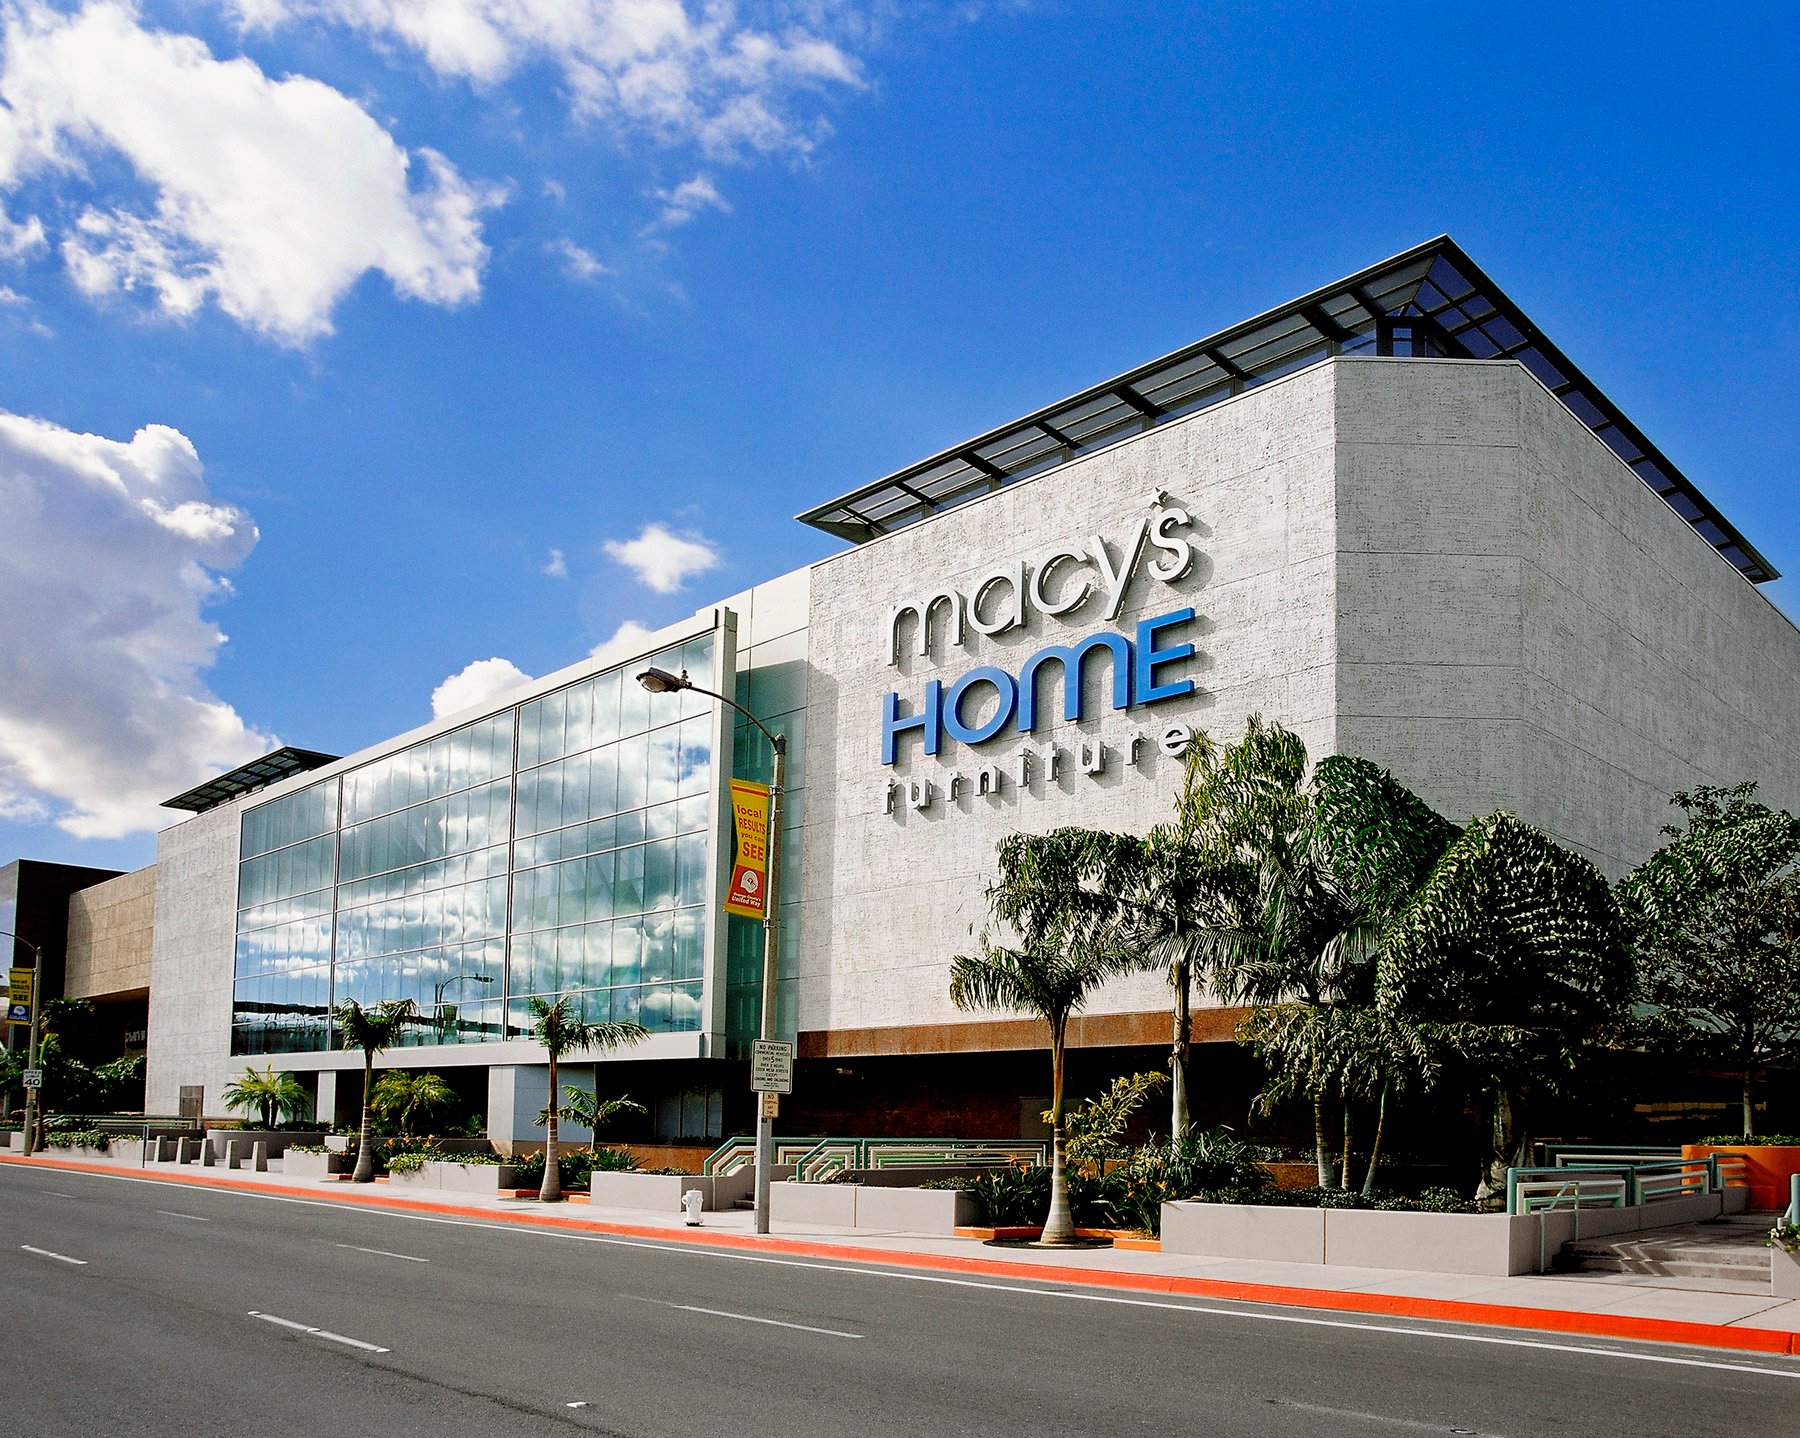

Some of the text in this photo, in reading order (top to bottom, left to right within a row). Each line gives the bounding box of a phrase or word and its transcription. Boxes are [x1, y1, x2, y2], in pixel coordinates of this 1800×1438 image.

[882, 607, 1195, 765] HOME
[882, 722, 1195, 815] furniture
[737, 804, 762, 819] local
[738, 817, 766, 836] RESULTS
[741, 832, 765, 844] you can
[742, 841, 764, 862] SEE
[731, 895, 761, 908] United Way
[24, 1078, 41, 1086] 40
